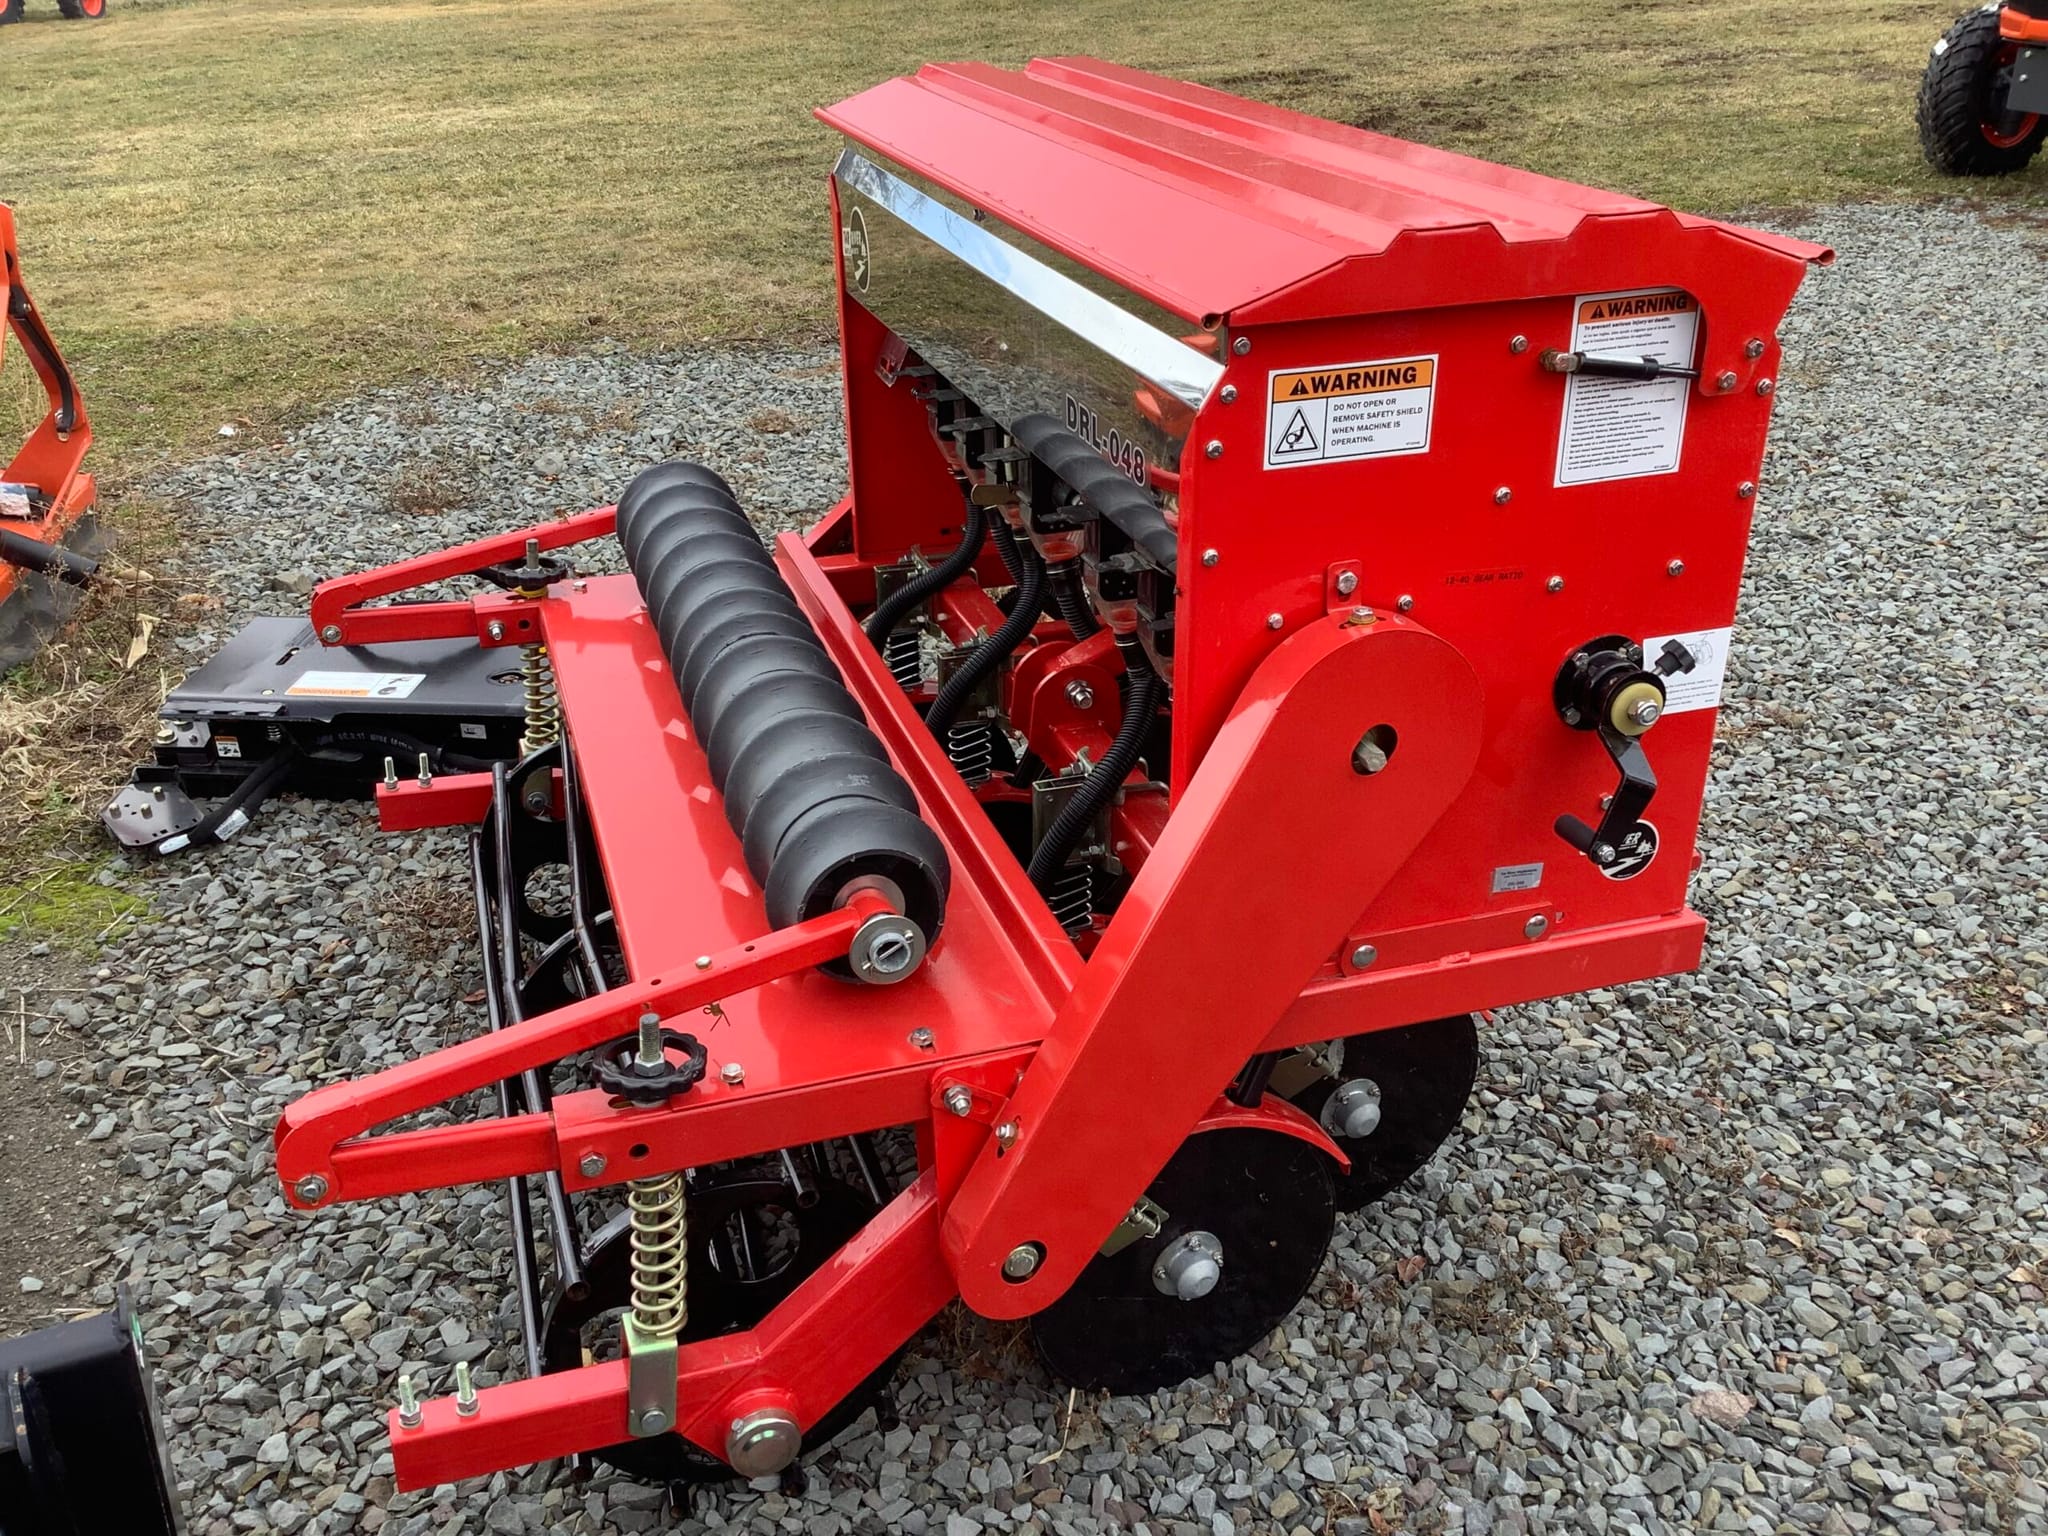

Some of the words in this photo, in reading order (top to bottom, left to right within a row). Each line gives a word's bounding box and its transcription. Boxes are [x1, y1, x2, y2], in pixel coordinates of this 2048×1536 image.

[1607, 294, 1687, 317] WARNING
[1310, 366, 1417, 394] WARNING
[1334, 403, 1344, 411] DO
[1347, 401, 1362, 410] NOT
[1363, 399, 1384, 408] OPEN
[1385, 398, 1397, 406] OR
[1332, 413, 1365, 423] REMOVE
[1366, 410, 1394, 420] SAFETY
[1396, 407, 1423, 417] SHIELD
[1331, 426, 1355, 435] WHEN
[1356, 422, 1392, 433] MACHINE
[1393, 420, 1401, 429] IS
[1065, 392, 1145, 487] DRL-048
[1331, 435, 1375, 447] OPERATING.
